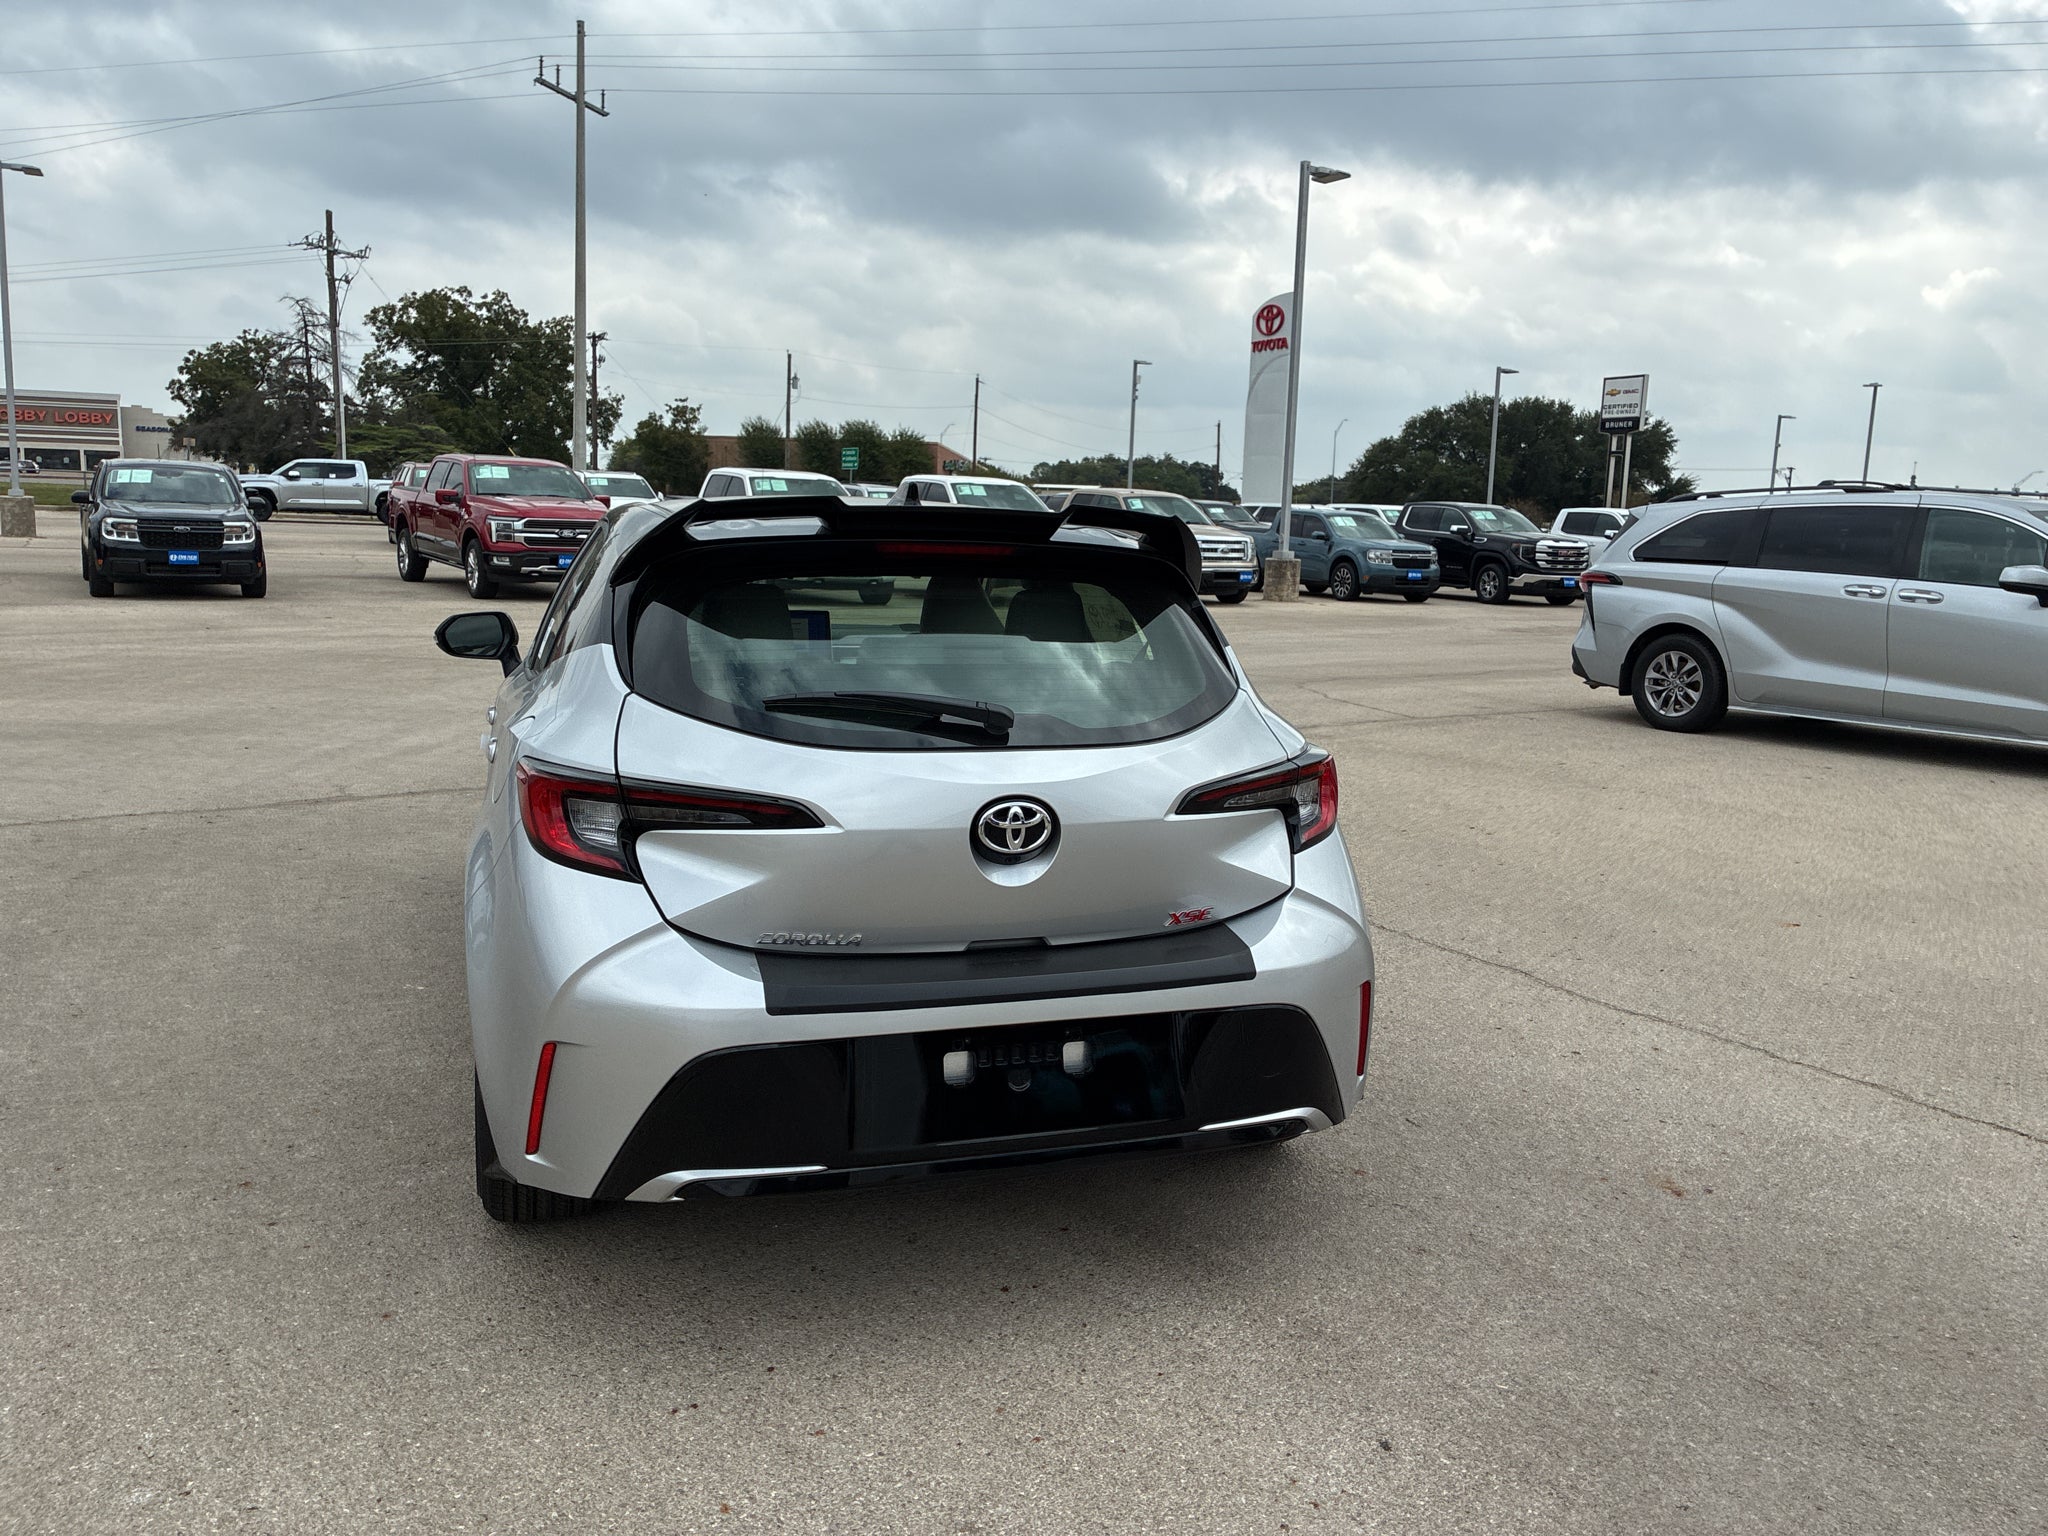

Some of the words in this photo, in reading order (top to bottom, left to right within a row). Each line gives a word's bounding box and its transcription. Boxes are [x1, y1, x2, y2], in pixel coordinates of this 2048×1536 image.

[1251, 337, 1289, 353] TOYOTA
[54, 411, 113, 424] LOBBY
[1605, 420, 1633, 428] BRUNER
[1163, 905, 1214, 927] XSE
[756, 932, 862, 947] COROLLA
